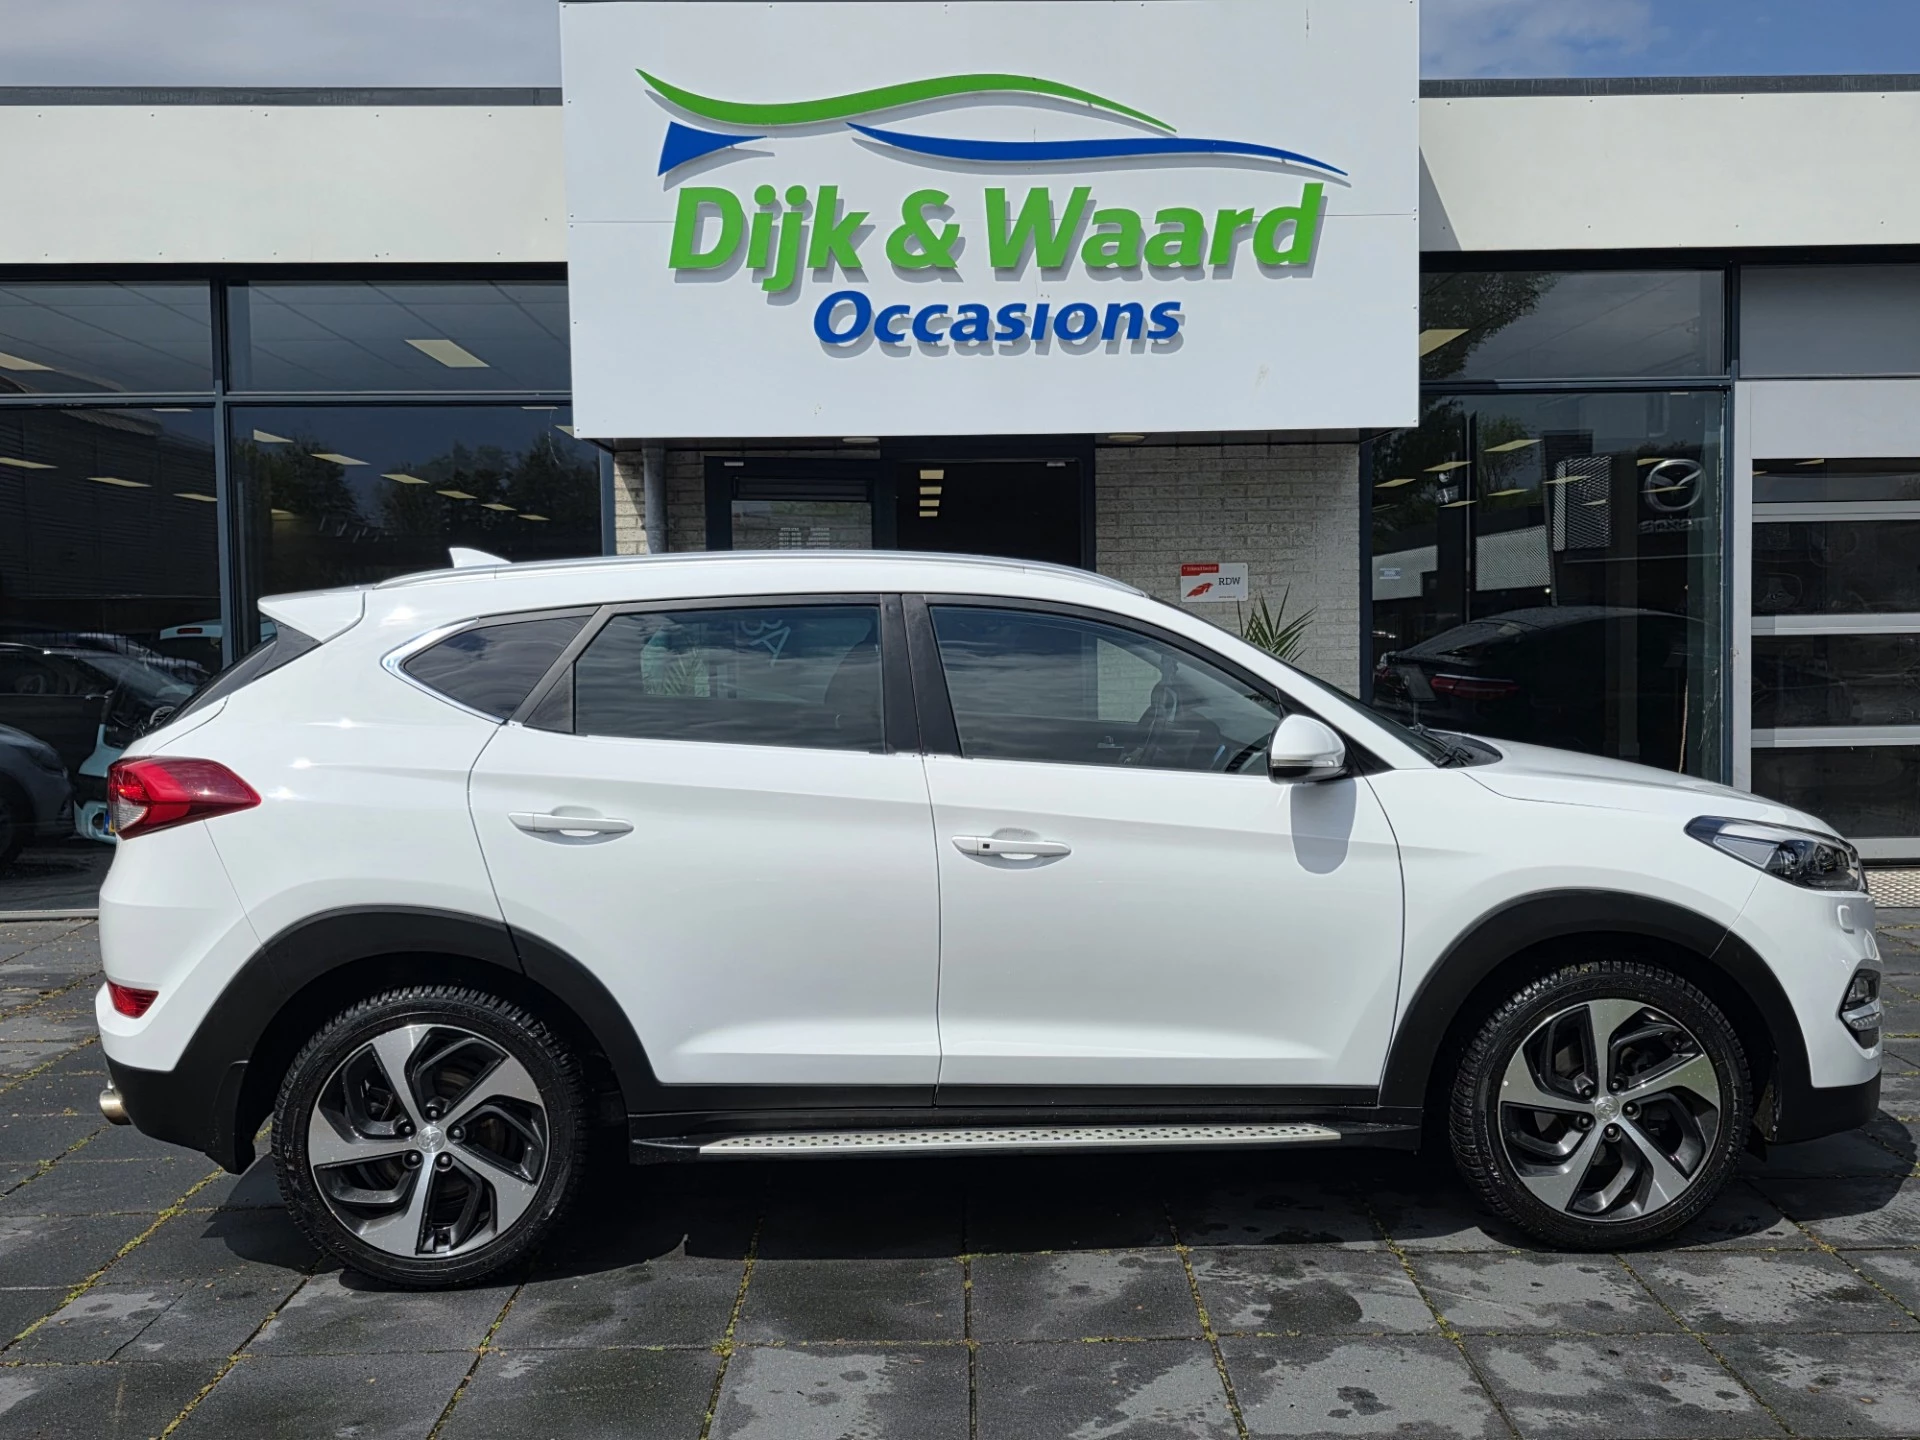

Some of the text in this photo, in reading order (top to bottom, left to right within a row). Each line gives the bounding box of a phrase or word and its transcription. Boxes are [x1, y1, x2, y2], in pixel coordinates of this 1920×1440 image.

[668, 182, 1324, 291] Dijk & Waard
[813, 290, 1181, 344] Occasions
[1218, 576, 1241, 586] RDW
